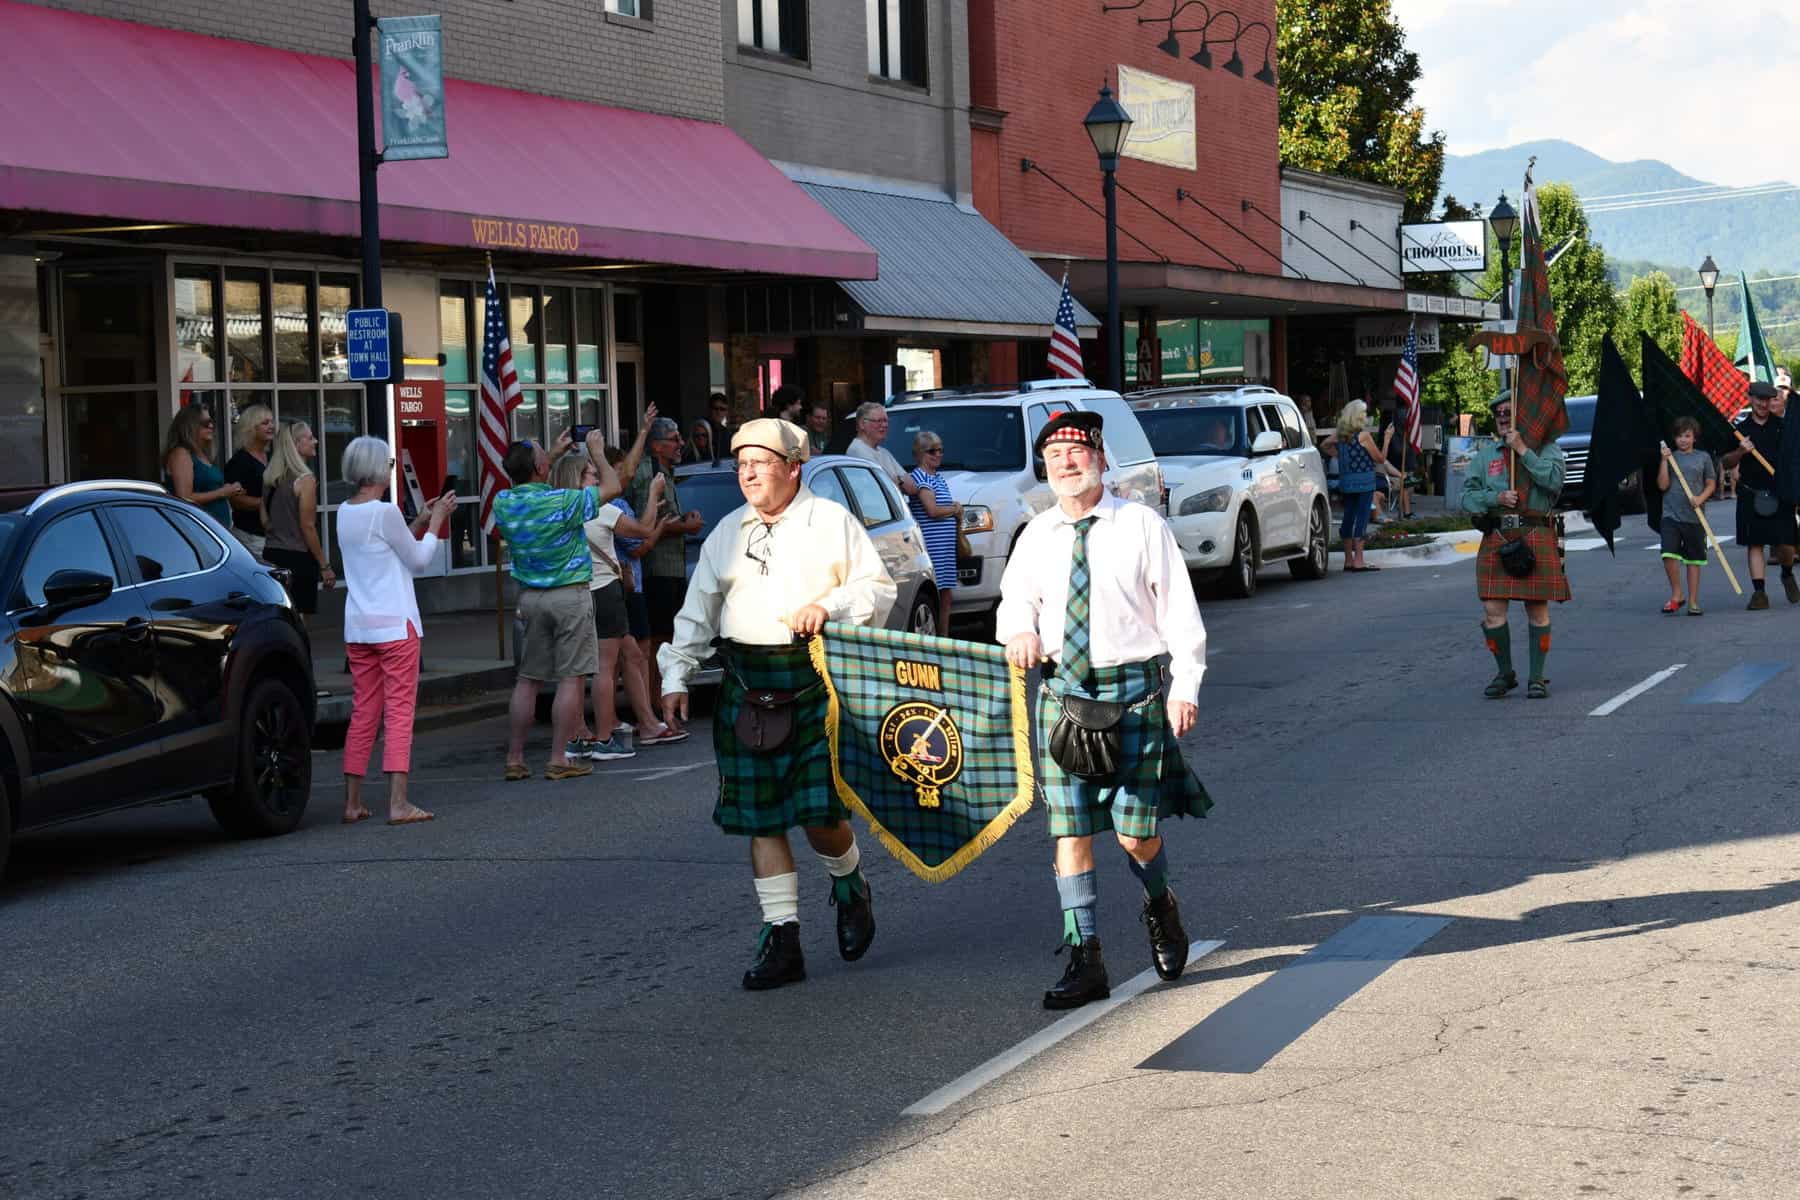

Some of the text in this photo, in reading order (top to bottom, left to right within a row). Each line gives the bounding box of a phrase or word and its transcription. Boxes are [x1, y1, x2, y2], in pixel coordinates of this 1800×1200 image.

[385, 33, 434, 55] Franklin
[472, 219, 579, 251] WELLS FARGO
[1404, 245, 1480, 259] CHOPHOUSE
[355, 317, 381, 327] PUBLIC
[350, 329, 386, 339] RESTROOM
[364, 341, 373, 350] AT
[1492, 335, 1526, 354] HAY
[350, 351, 387, 363] TOWN HALL
[400, 387, 422, 398] WELLS
[400, 401, 423, 413] FARGO
[895, 661, 940, 690] GUNN
